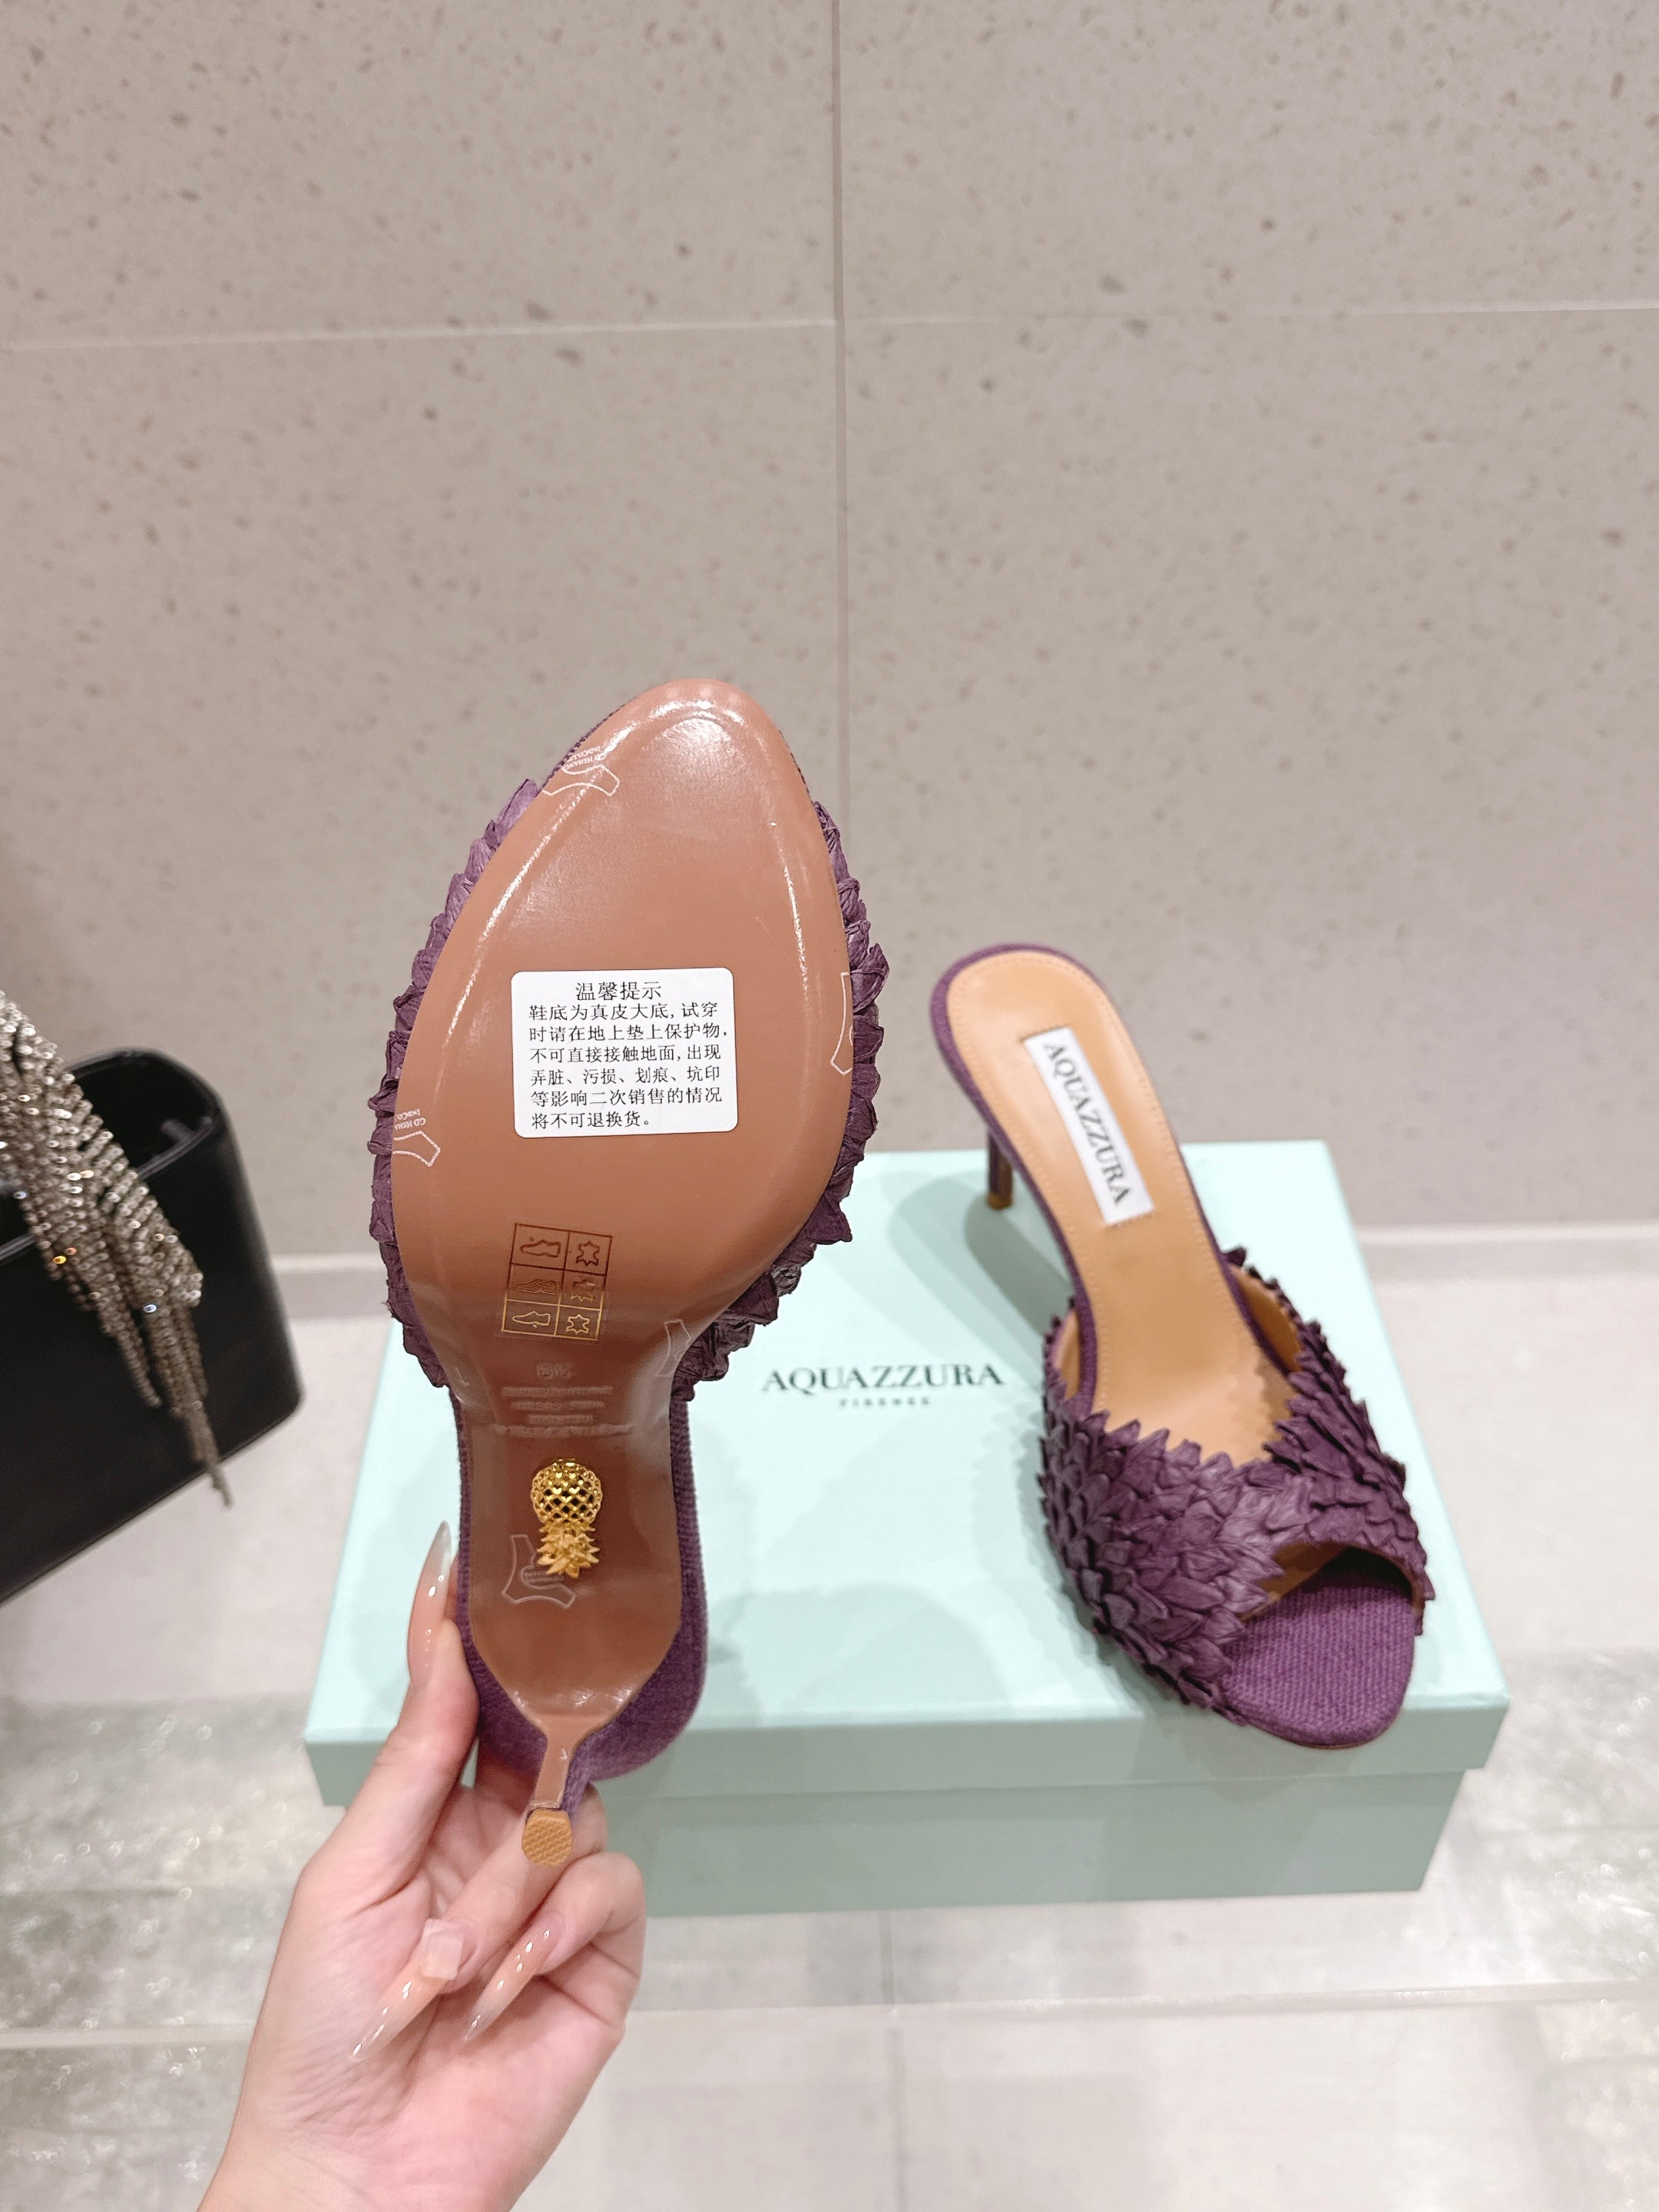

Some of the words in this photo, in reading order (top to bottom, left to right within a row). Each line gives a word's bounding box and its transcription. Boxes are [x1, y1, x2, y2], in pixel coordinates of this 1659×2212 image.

[576, 982, 661, 1001] 温馨提示
[529, 1002, 718, 1021] 鞋底为真皮大底，试穿
[529, 1022, 727, 1042] 时请在地上垫上保护物，
[530, 1044, 721, 1064] 不可直接接触地面，出现
[531, 1065, 720, 1086] 弄脏、污损、划痕、坑印
[531, 1087, 723, 1108] 等影响二次销售的情况
[531, 1111, 650, 1129] 将不可退换货。
[1044, 1041, 1131, 1206] AQUAZZURA
[762, 1363, 1007, 1396] AQUAZZURA
